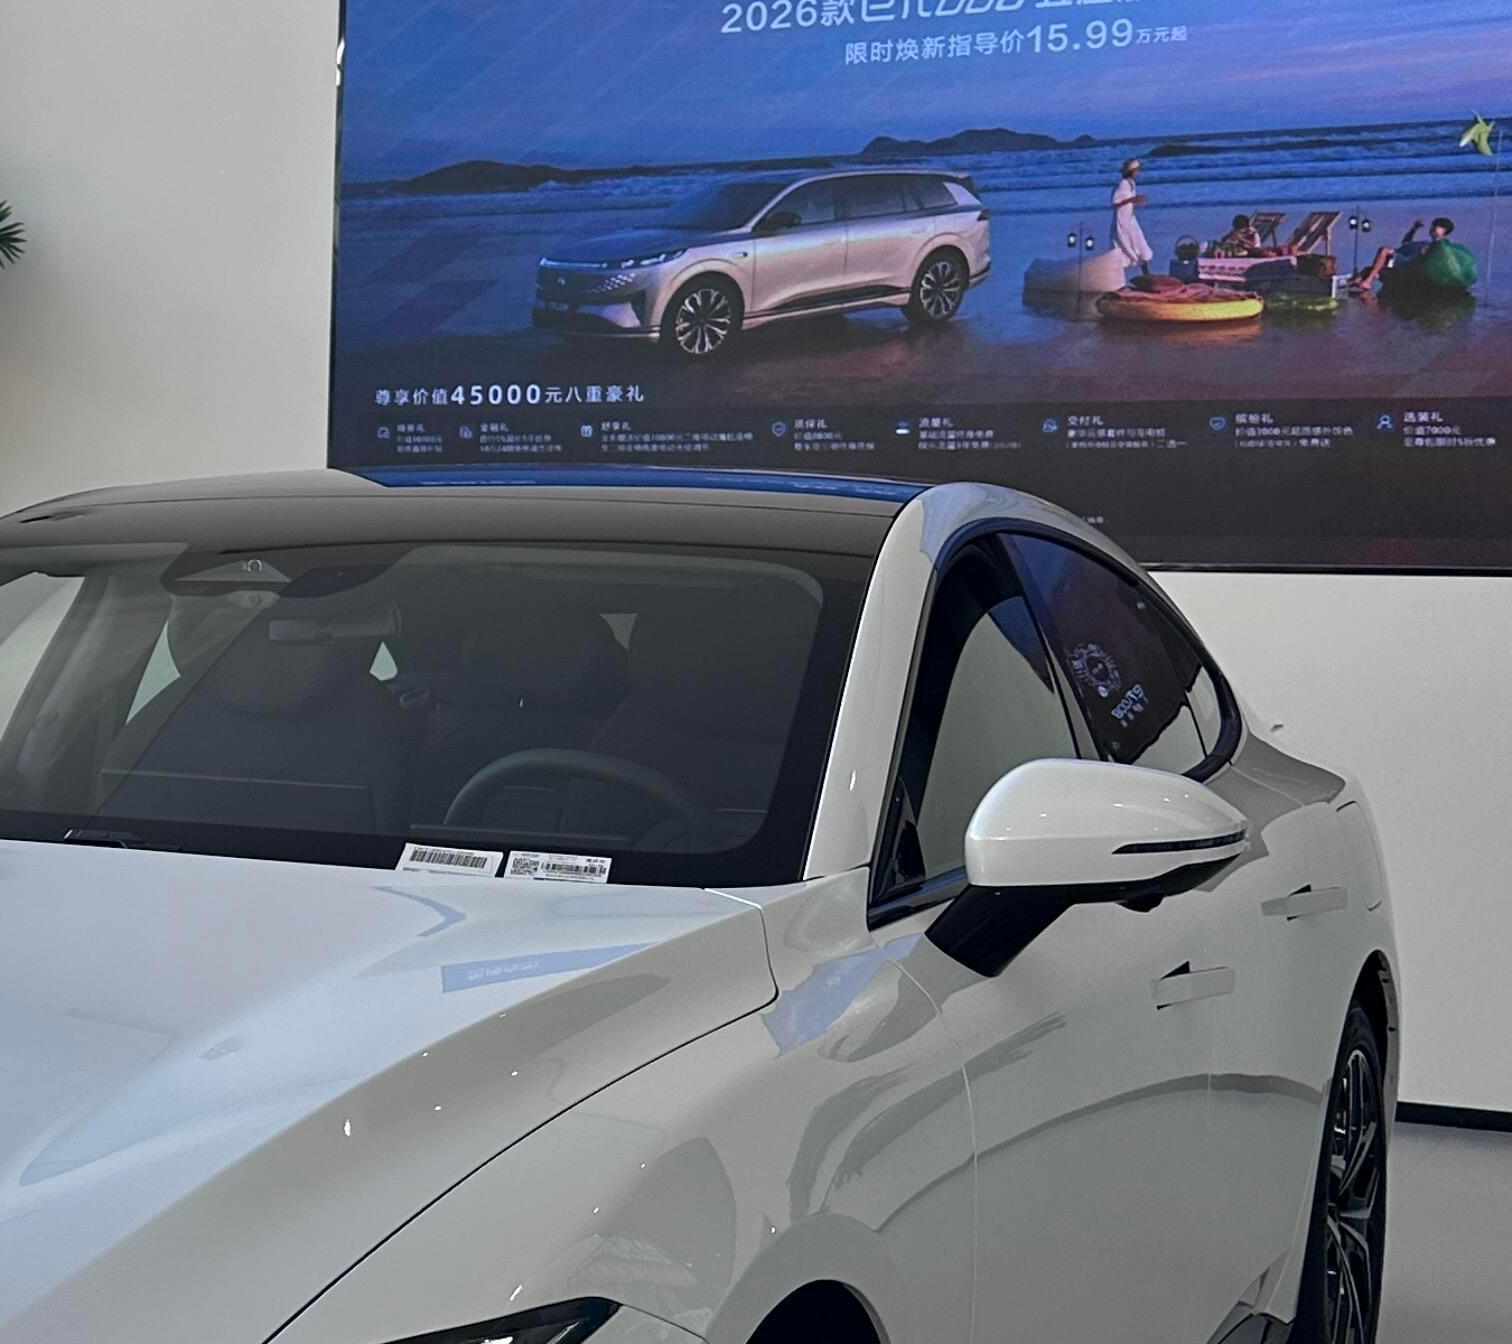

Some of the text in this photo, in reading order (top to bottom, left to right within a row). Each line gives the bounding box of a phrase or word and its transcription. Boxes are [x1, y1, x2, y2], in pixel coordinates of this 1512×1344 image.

[845, 18, 1188, 65] 限时焕新指导价15.99万元起
[374, 383, 645, 406] 尊享价值45000元八重豪礼
